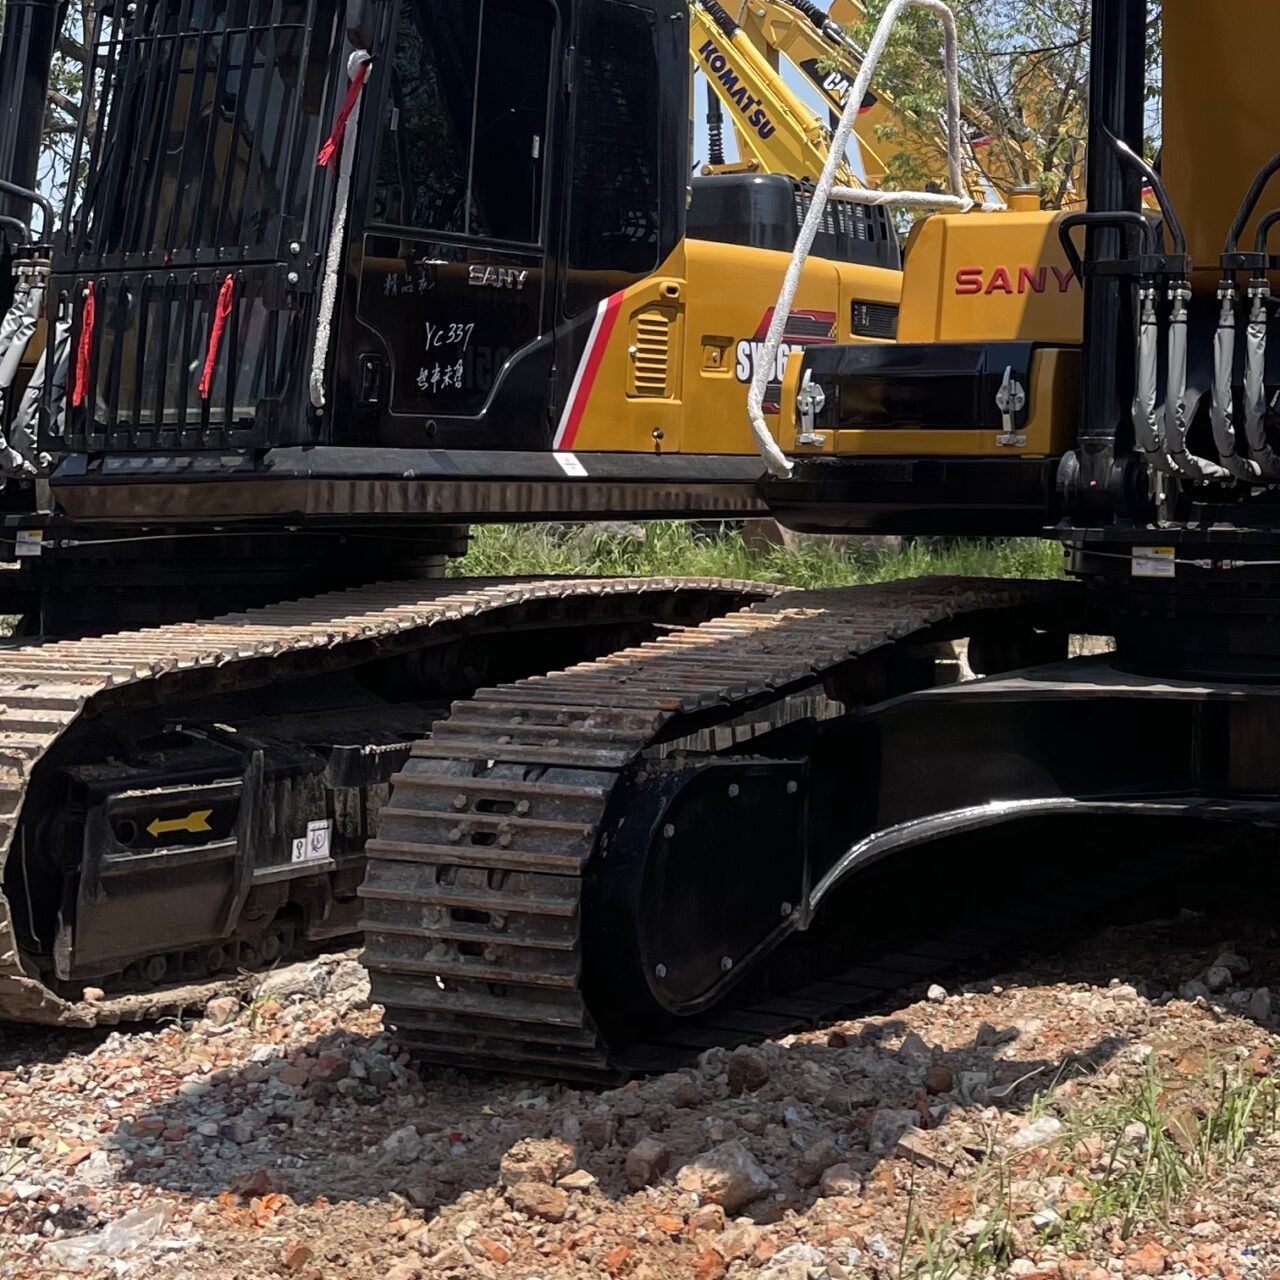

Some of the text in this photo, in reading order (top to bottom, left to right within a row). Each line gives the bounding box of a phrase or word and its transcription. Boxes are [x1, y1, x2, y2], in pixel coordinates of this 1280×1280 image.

[698, 39, 776, 140] KOMATSU
[468, 265, 529, 290] SANY
[955, 265, 1076, 295] SANY
